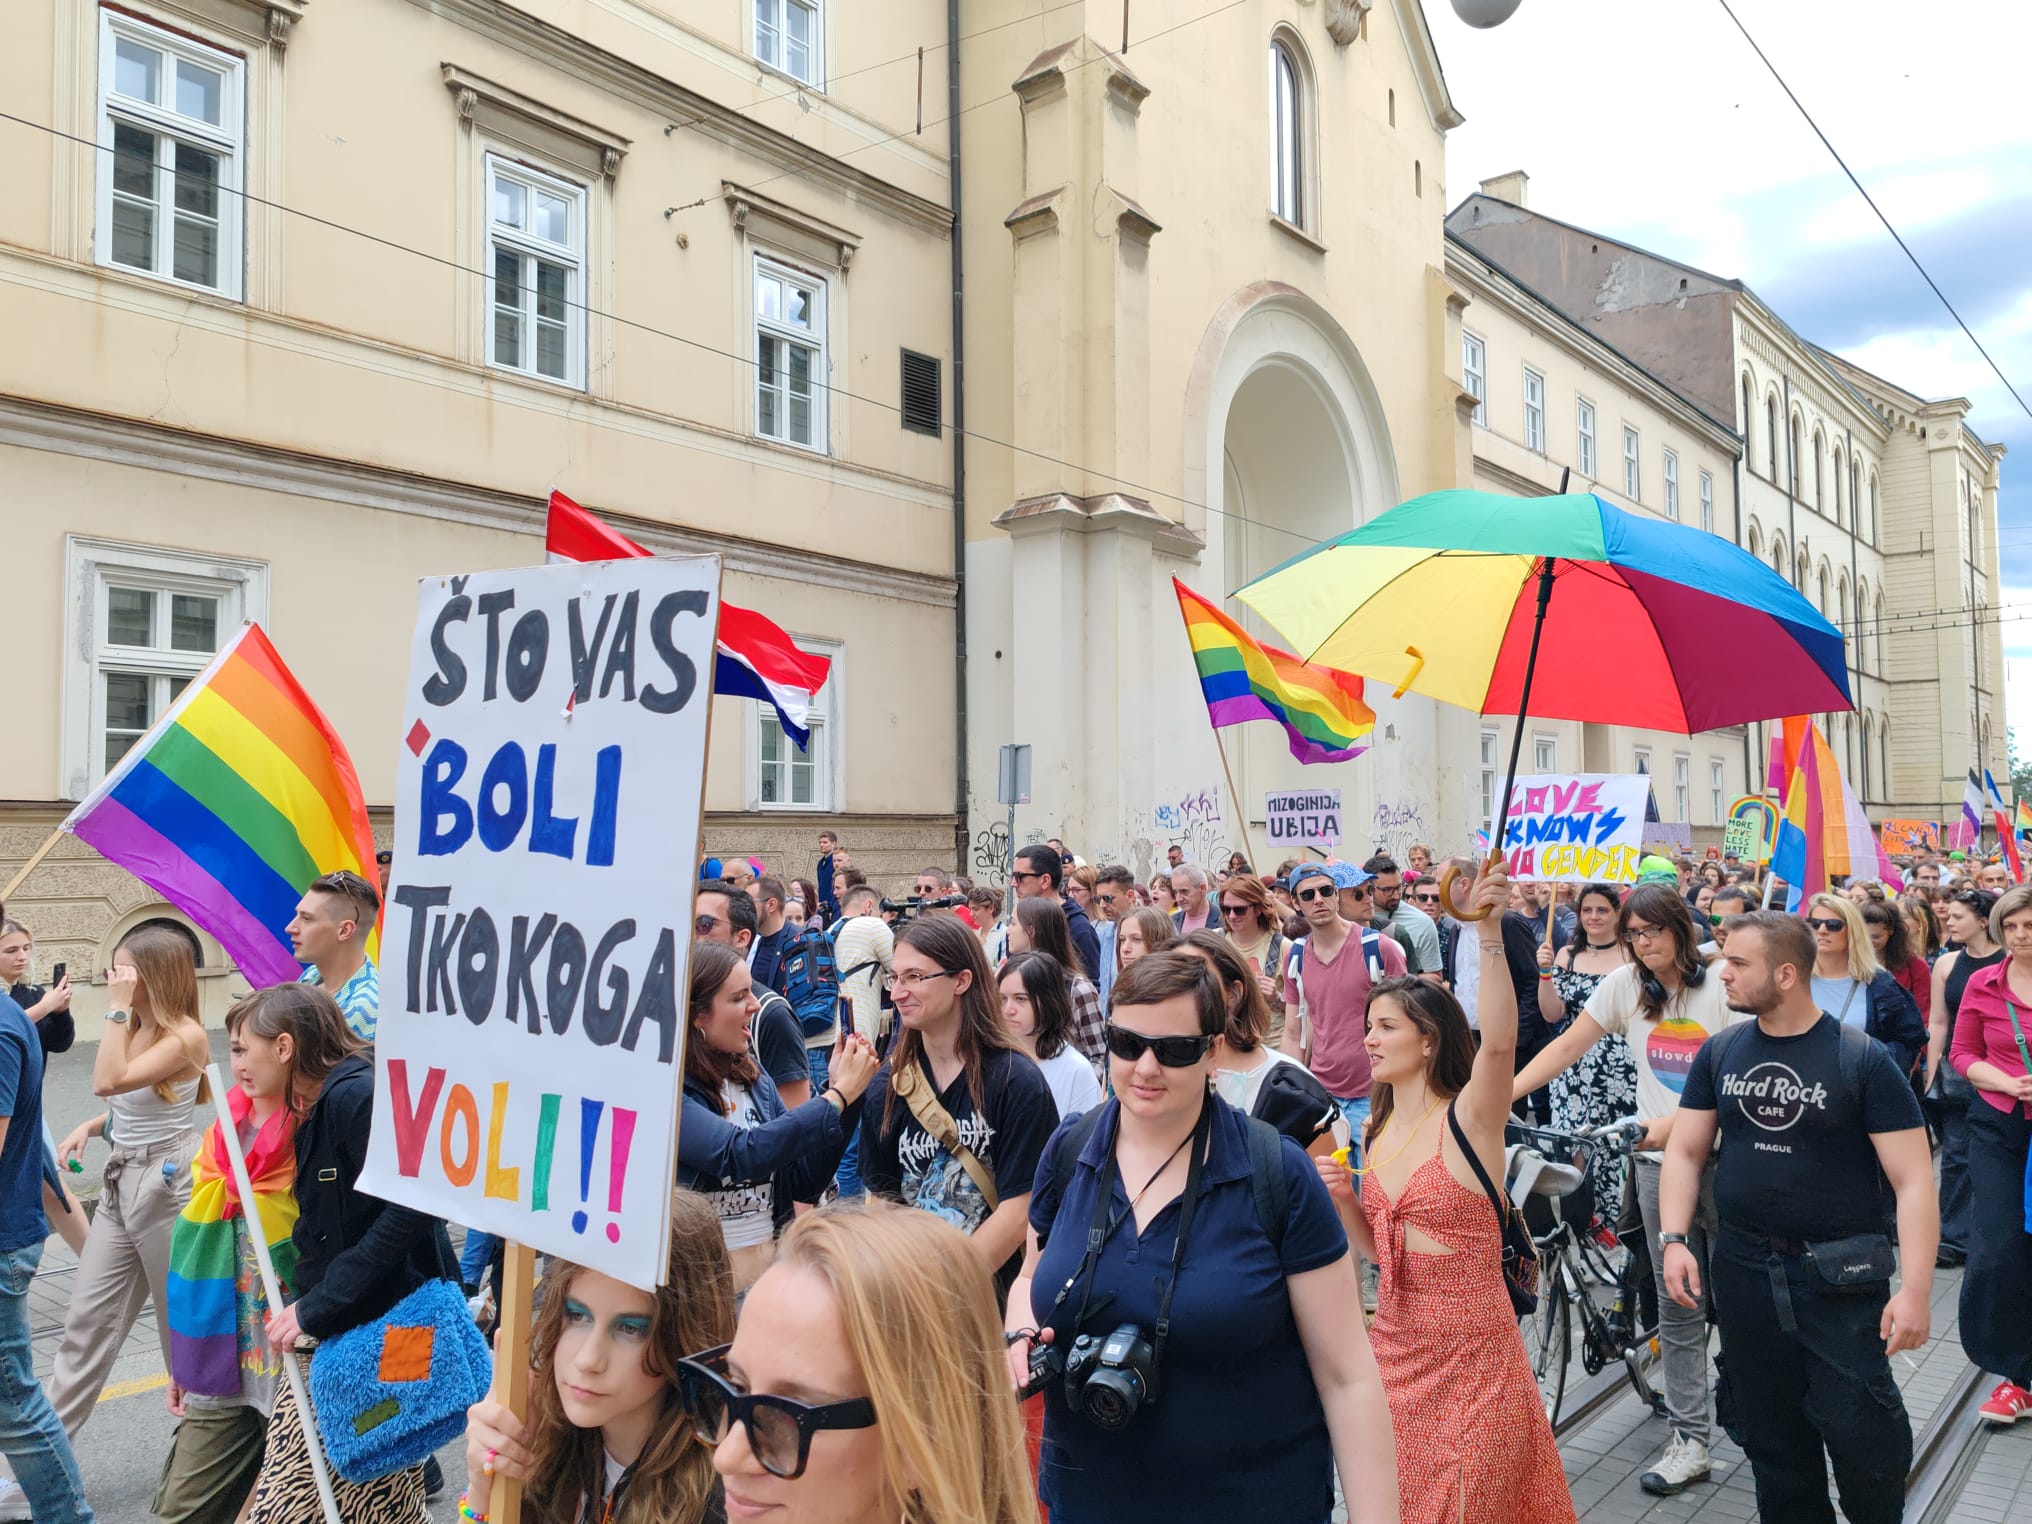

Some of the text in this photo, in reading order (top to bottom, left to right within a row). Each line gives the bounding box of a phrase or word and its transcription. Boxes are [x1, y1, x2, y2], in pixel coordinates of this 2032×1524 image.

[422, 574, 710, 715] ŠTO VAS
[418, 738, 622, 866] BOLI
[1268, 796, 1340, 813] MIZOGINIJA
[1508, 780, 1605, 816] LOVE
[1271, 815, 1339, 838] UBIJA
[1505, 807, 1626, 848] KNOWS
[1727, 827, 1752, 838] LOVE
[1728, 819, 1753, 830] MORE
[1725, 845, 1749, 854] HATE
[1726, 836, 1750, 846] LESS
[1541, 842, 1640, 882] GENDER
[393, 884, 678, 1065] TKO KOGA
[1651, 1047, 1698, 1064] slowd
[1721, 1073, 1828, 1111] Hard Rock
[1757, 1105, 1785, 1118] CAFE
[1754, 1142, 1793, 1154] PRAGUE
